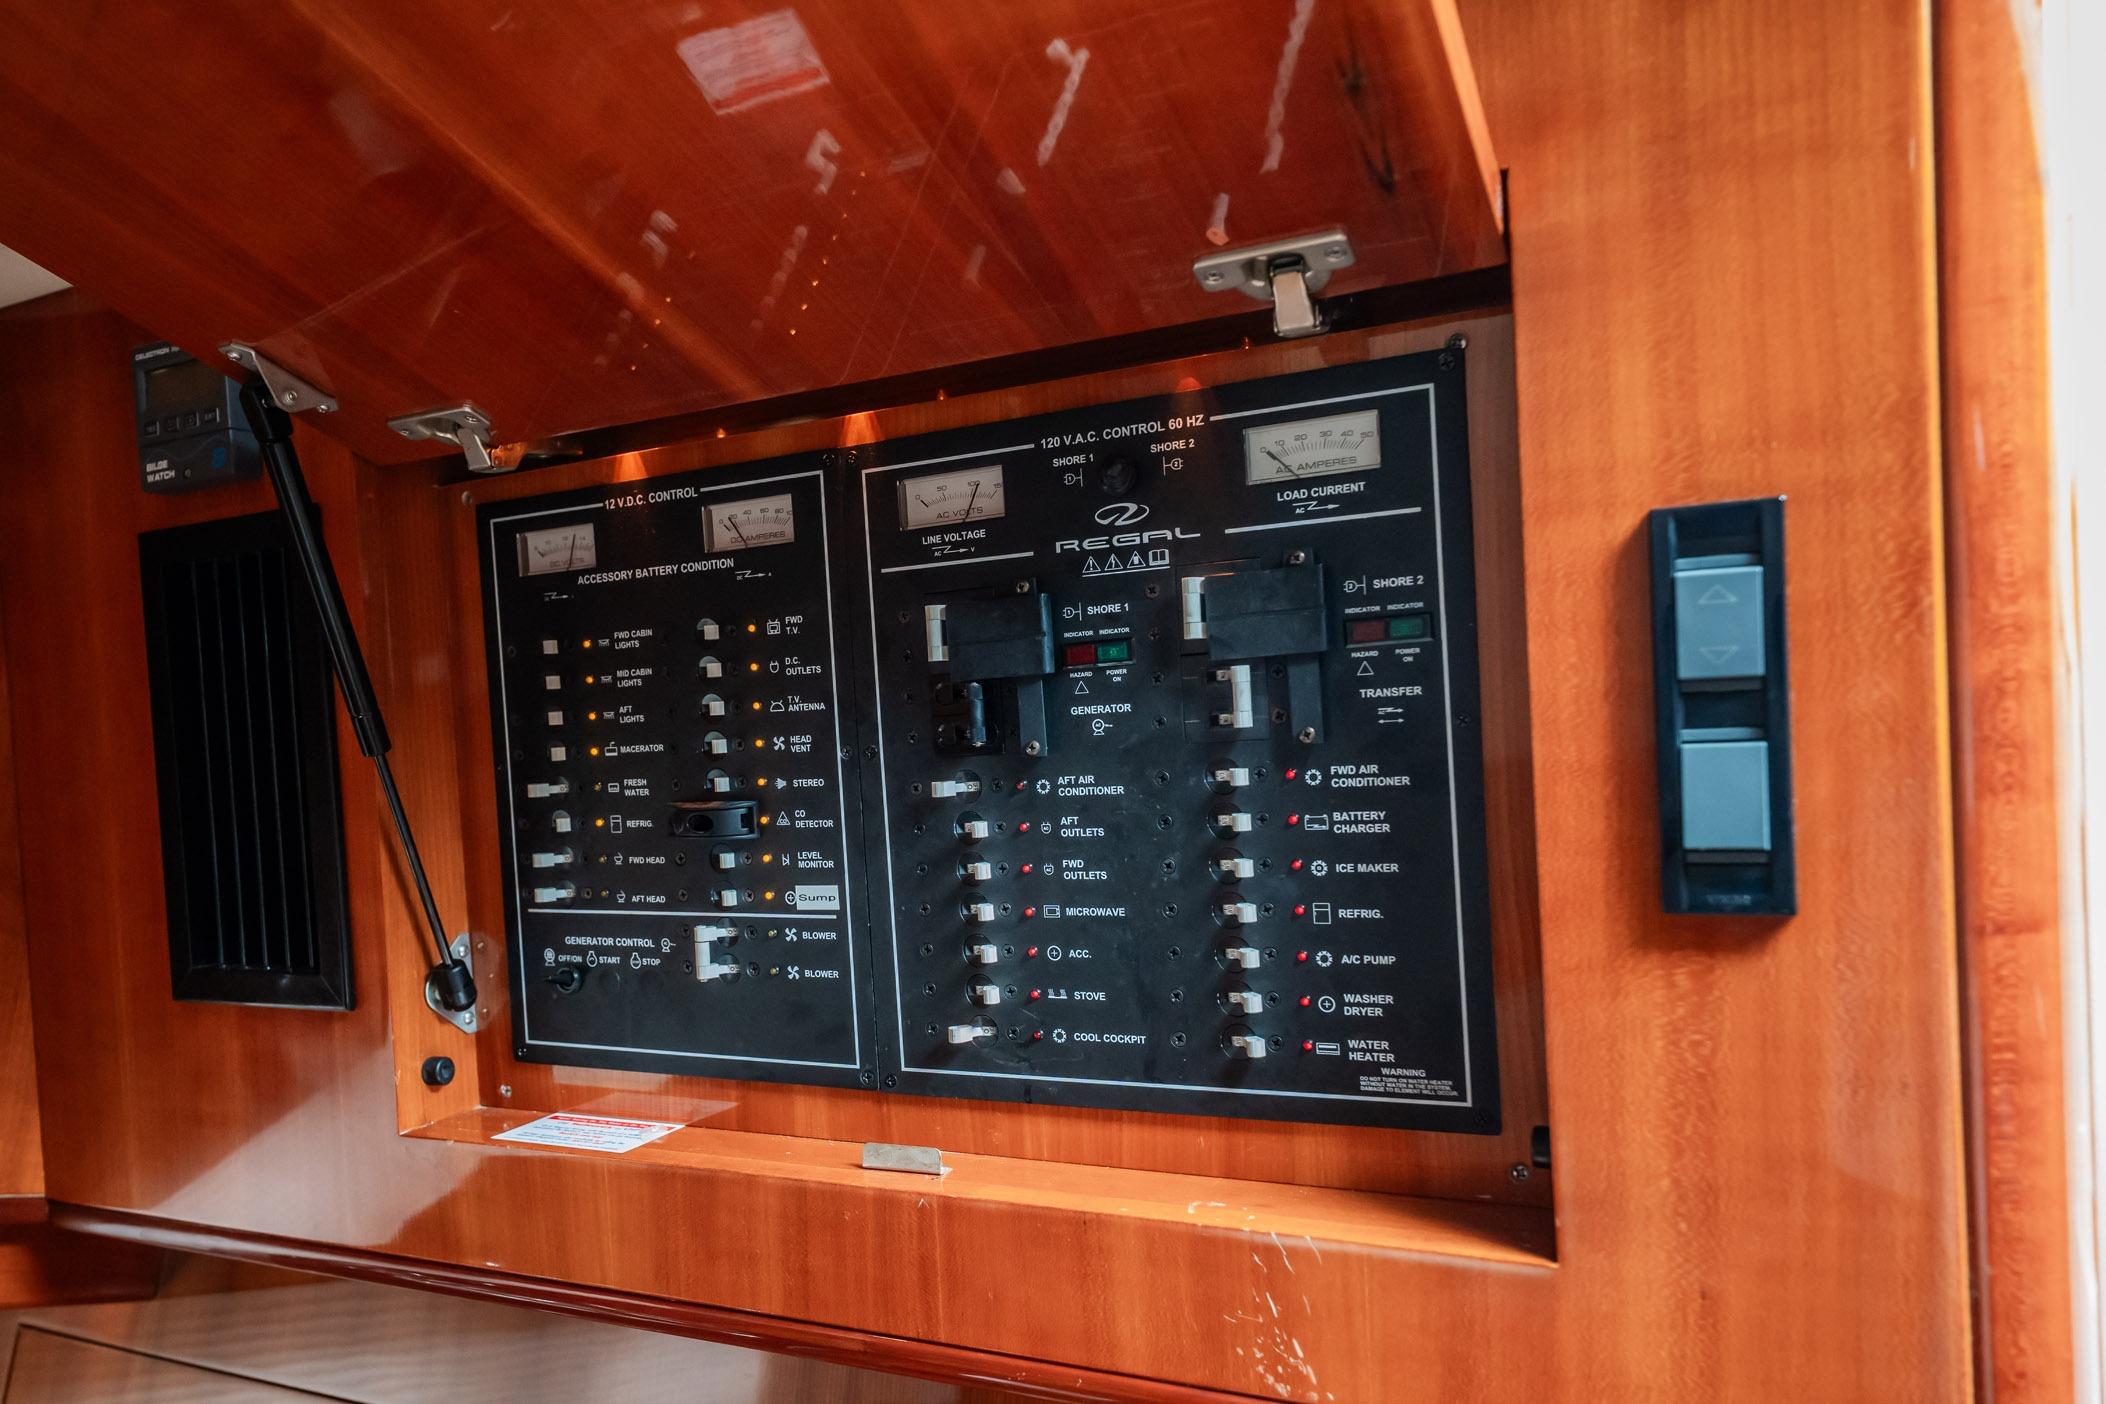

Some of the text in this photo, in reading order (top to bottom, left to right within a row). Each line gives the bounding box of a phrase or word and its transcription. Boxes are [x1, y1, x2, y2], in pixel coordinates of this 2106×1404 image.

[1040, 414, 1204, 449] 120 V.A.C. CONTROL 60 HZ
[1150, 438, 1195, 453] SHORE 2
[1052, 454, 1094, 467] SHORE 1
[1276, 456, 1357, 474] AC AMPERES
[146, 460, 168, 472] BILGE
[147, 470, 175, 483] WATCH
[1277, 481, 1366, 501] LOAD CURRENT
[605, 487, 698, 509] 12 V.D.C. CONTROL
[745, 531, 786, 541] AMPERES
[922, 529, 986, 545] LINE VOLTAGE
[1055, 527, 1201, 553] REGAL
[577, 557, 734, 585] ACCESSORY BATTERY CONDITION
[1373, 575, 1424, 589] SHORE 2
[1087, 603, 1129, 615] SHORE 1
[1344, 602, 1424, 614] INDICATOR INDICATOR
[785, 616, 803, 624] FWD
[614, 628, 653, 639] FWD CABIN
[1064, 627, 1130, 638] INDICATOR INDICATOR
[614, 640, 640, 649] LIGHTS
[1351, 650, 1379, 658] HAZARD
[785, 657, 800, 665] D.C.
[616, 668, 652, 677] MID CABIN
[786, 666, 822, 675] OUTLETS
[617, 679, 642, 688] LIGHTS
[1359, 686, 1422, 698] TRANSFER
[788, 702, 826, 712] ANTENNA
[1071, 703, 1131, 715] GENERATOR
[620, 714, 645, 723] LIGHTS
[790, 735, 812, 743] HEAD
[620, 744, 664, 753] MACERATOR
[790, 744, 811, 752] VENT
[1330, 764, 1379, 775] FWD AIR
[793, 779, 824, 787] STEREO
[1057, 775, 1095, 785] AFT AIR
[1331, 776, 1411, 788] CONDITIONER
[1058, 786, 1125, 796] CONDITIONER
[1060, 817, 1079, 825] AFT
[1333, 811, 1386, 821] BATTERY
[795, 820, 834, 828] DETECTOR
[1334, 824, 1391, 833] CHARGER
[1061, 828, 1105, 837] OUTLETS
[628, 856, 666, 864] FWD HEAD
[798, 851, 822, 859] LEVEL
[1062, 860, 1084, 868] FWD
[1335, 863, 1399, 873] ICE MAKER
[1064, 871, 1107, 880] OUTLETS
[798, 894, 836, 902] Sump
[1066, 908, 1126, 917] MICROWAVE
[1338, 909, 1384, 918] REFRIG.
[802, 932, 836, 940] BLOWER
[565, 936, 655, 948] GENERATOR CONTROL
[558, 955, 582, 963] OFF/ON
[1069, 950, 1092, 958] ACC.
[642, 958, 661, 966] STOP
[1341, 955, 1396, 965] A/C PUMP
[804, 970, 839, 978] BLOWER
[1074, 991, 1106, 1001] STOVE
[1343, 994, 1394, 1004] WASHER
[1344, 1006, 1383, 1016] DRYER
[1074, 1032, 1146, 1044] COOL COCKPIT
[1348, 1040, 1389, 1050] WATER
[1348, 1051, 1395, 1063] HEATER
[1380, 1067, 1426, 1077] WARNING
